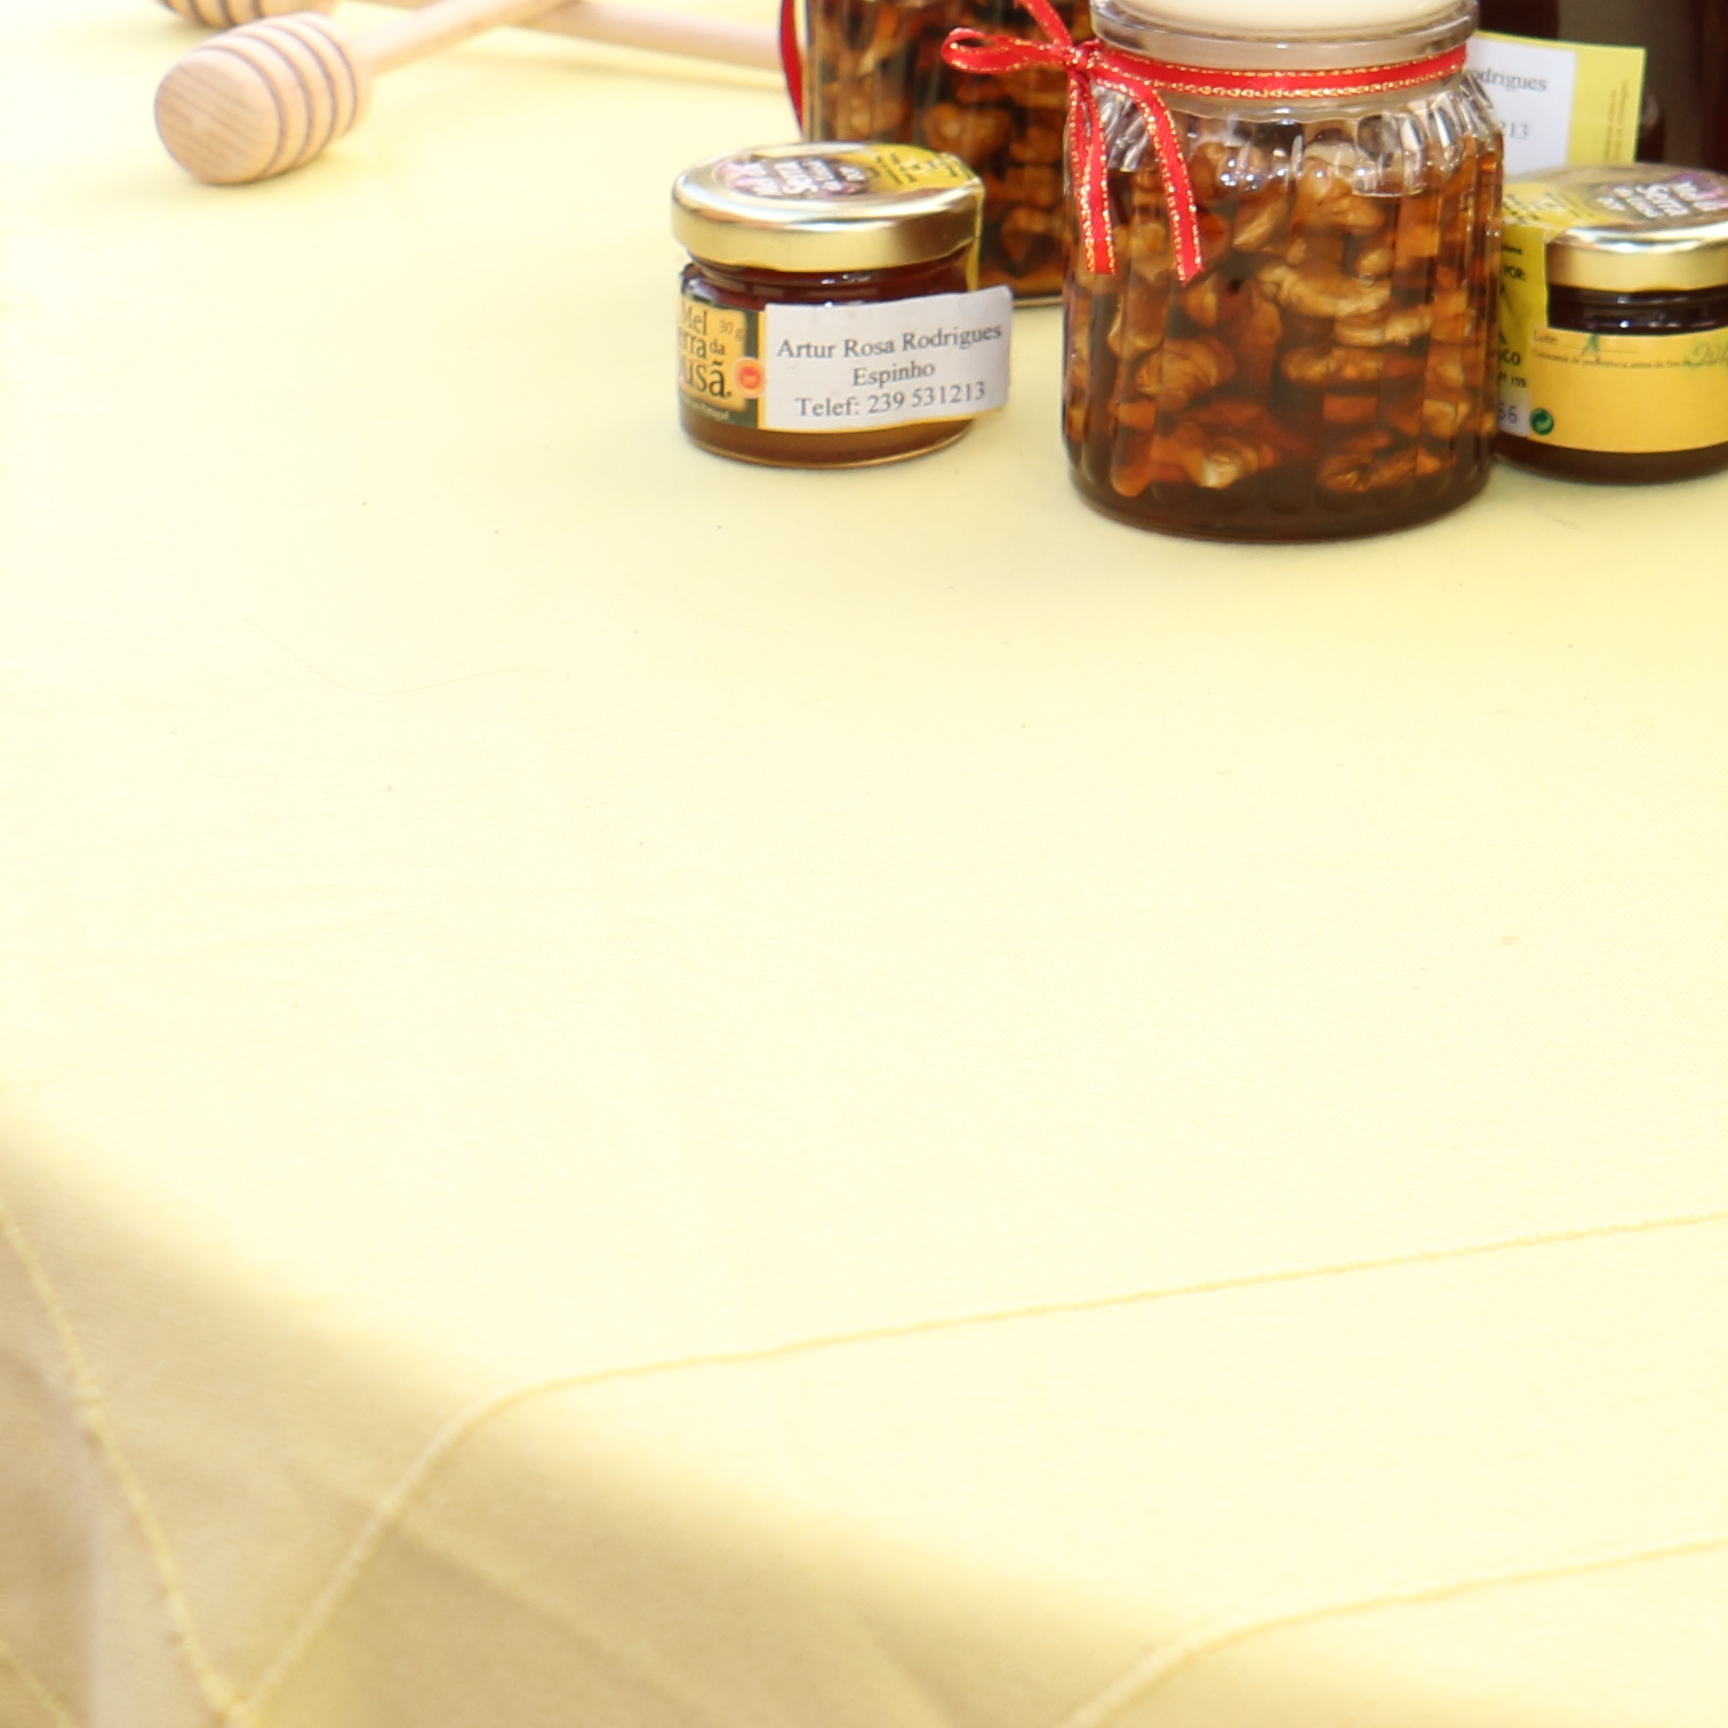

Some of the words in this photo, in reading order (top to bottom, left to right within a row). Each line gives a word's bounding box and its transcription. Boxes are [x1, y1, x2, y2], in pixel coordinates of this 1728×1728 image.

[709, 337, 726, 355] da
[776, 338, 836, 359] Artur
[843, 334, 894, 358] Rosa
[902, 322, 1002, 350] Rodrigues
[852, 361, 935, 389] Espinho
[795, 395, 860, 418] Telef:
[867, 389, 905, 414] 239
[911, 380, 986, 408] 531213
